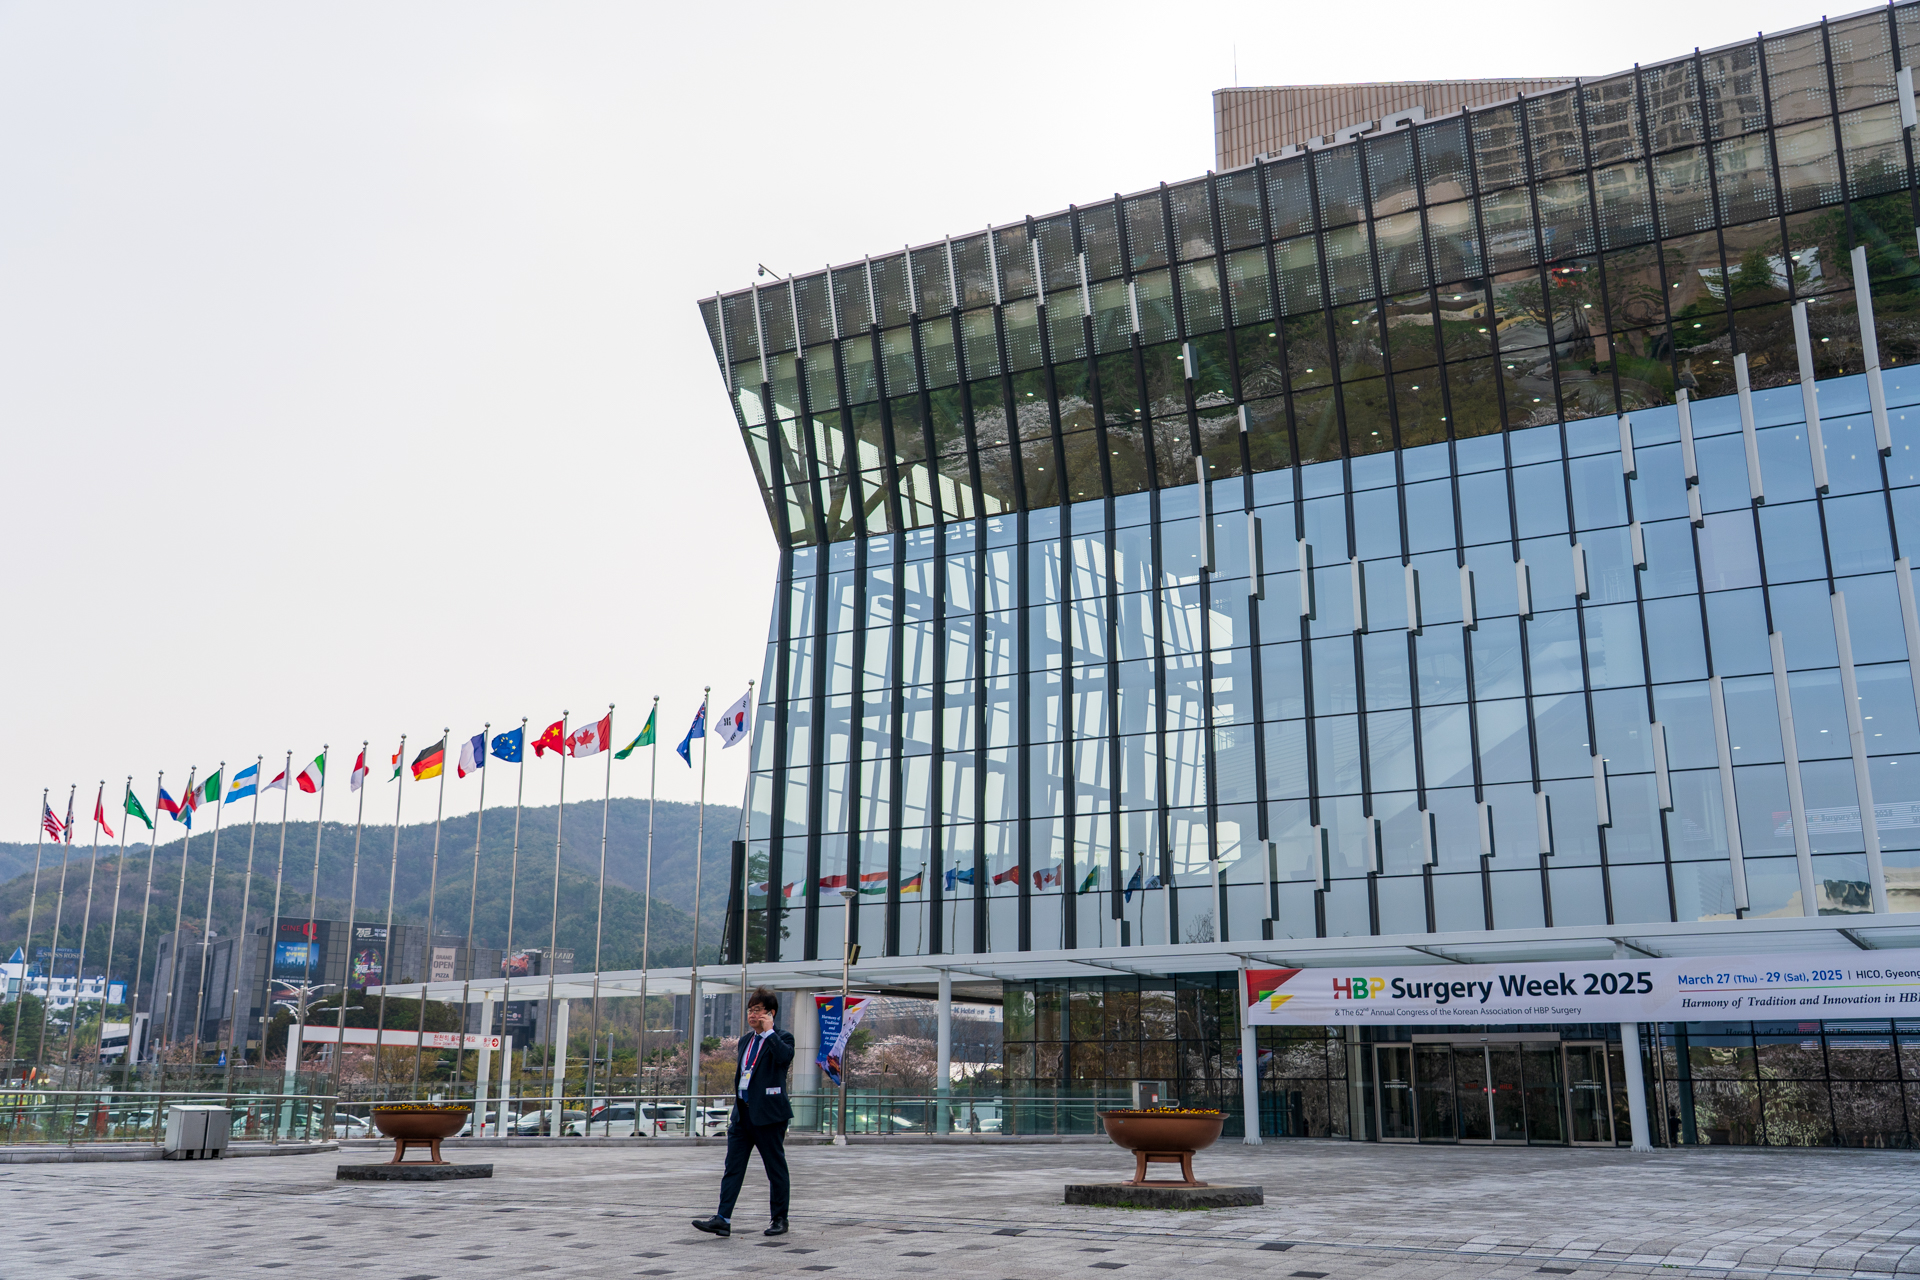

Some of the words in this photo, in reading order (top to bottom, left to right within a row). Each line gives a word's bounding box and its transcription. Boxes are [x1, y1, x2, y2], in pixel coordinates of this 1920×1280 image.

[281, 924, 301, 932] CINE
[433, 960, 454, 969] OPEN
[1678, 974, 1714, 985] March
[1716, 973, 1730, 984] 27
[1733, 973, 1757, 984] (Thu)
[1766, 971, 1780, 982] 29
[1783, 972, 1809, 983] (Sat),
[1812, 969, 1843, 981] 2025
[1856, 969, 1883, 980] HICO,
[1332, 977, 1386, 1000] HBP
[1391, 977, 1493, 1005] Surgery
[1498, 972, 1578, 997] Week
[1583, 971, 1653, 996] 2025
[1682, 998, 1729, 1010] Harmony
[1731, 997, 1743, 1009] of
[1748, 996, 1796, 1007] Tradition
[1799, 995, 1820, 1006] and
[1823, 994, 1881, 1005] Innovation
[1884, 993, 1895, 1003] in
[1370, 1008, 1395, 1016] Annual
[1397, 1008, 1429, 1018] Congress
[1430, 1007, 1438, 1016] of
[1439, 1008, 1451, 1016] the
[1453, 1008, 1479, 1016] Korean
[1480, 1007, 1523, 1015] Association
[1524, 1006, 1532, 1015] of
[1533, 1006, 1550, 1014] HBP
[1552, 1006, 1582, 1016] Surgery
[450, 1035, 476, 1043] 올라세요
